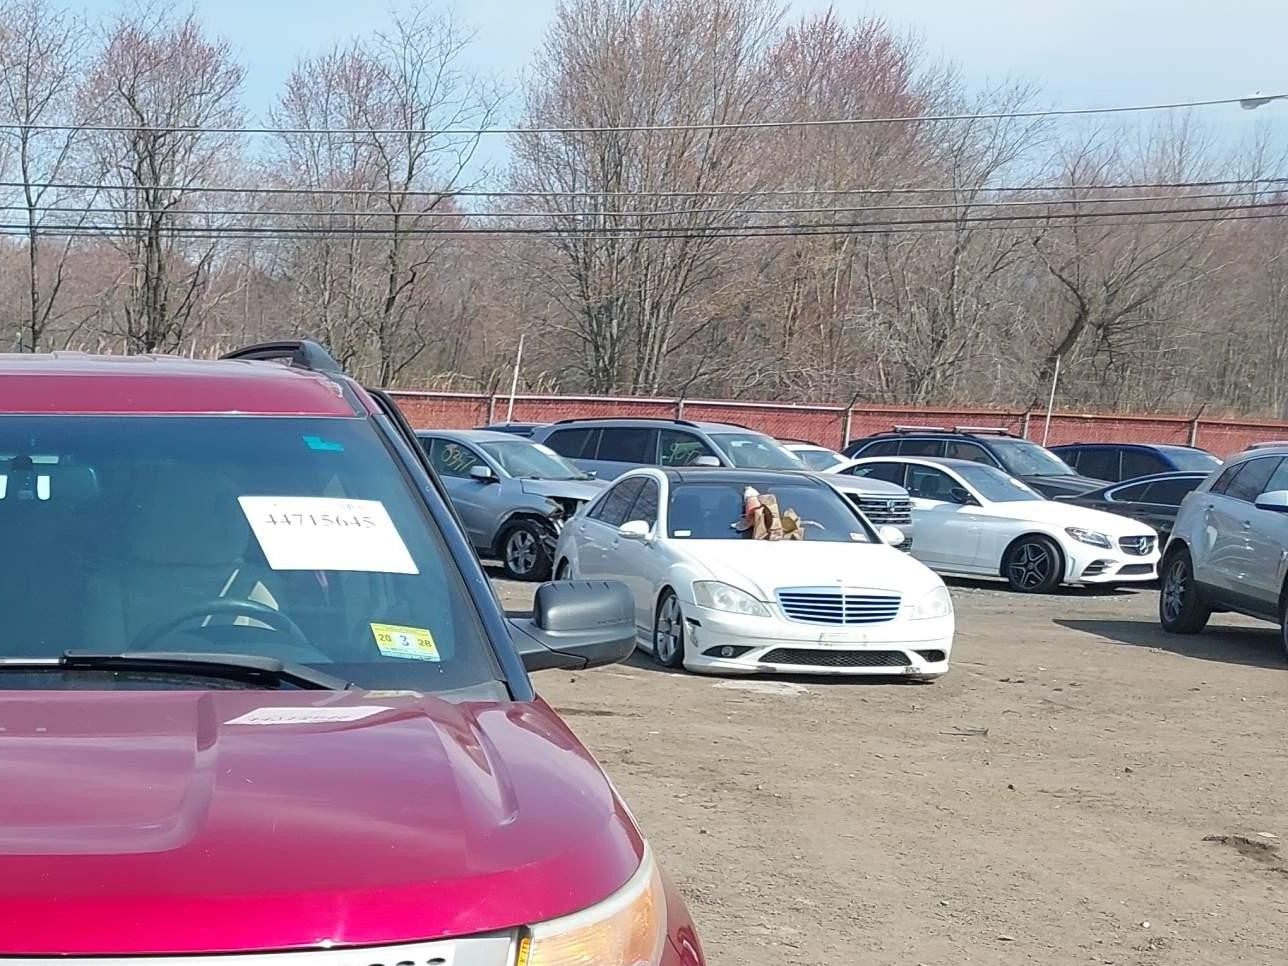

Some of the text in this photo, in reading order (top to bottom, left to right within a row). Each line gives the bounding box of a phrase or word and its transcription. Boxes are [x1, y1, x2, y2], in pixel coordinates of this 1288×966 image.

[264, 513, 377, 529] 44715645
[378, 633, 433, 648] 20 3 28
